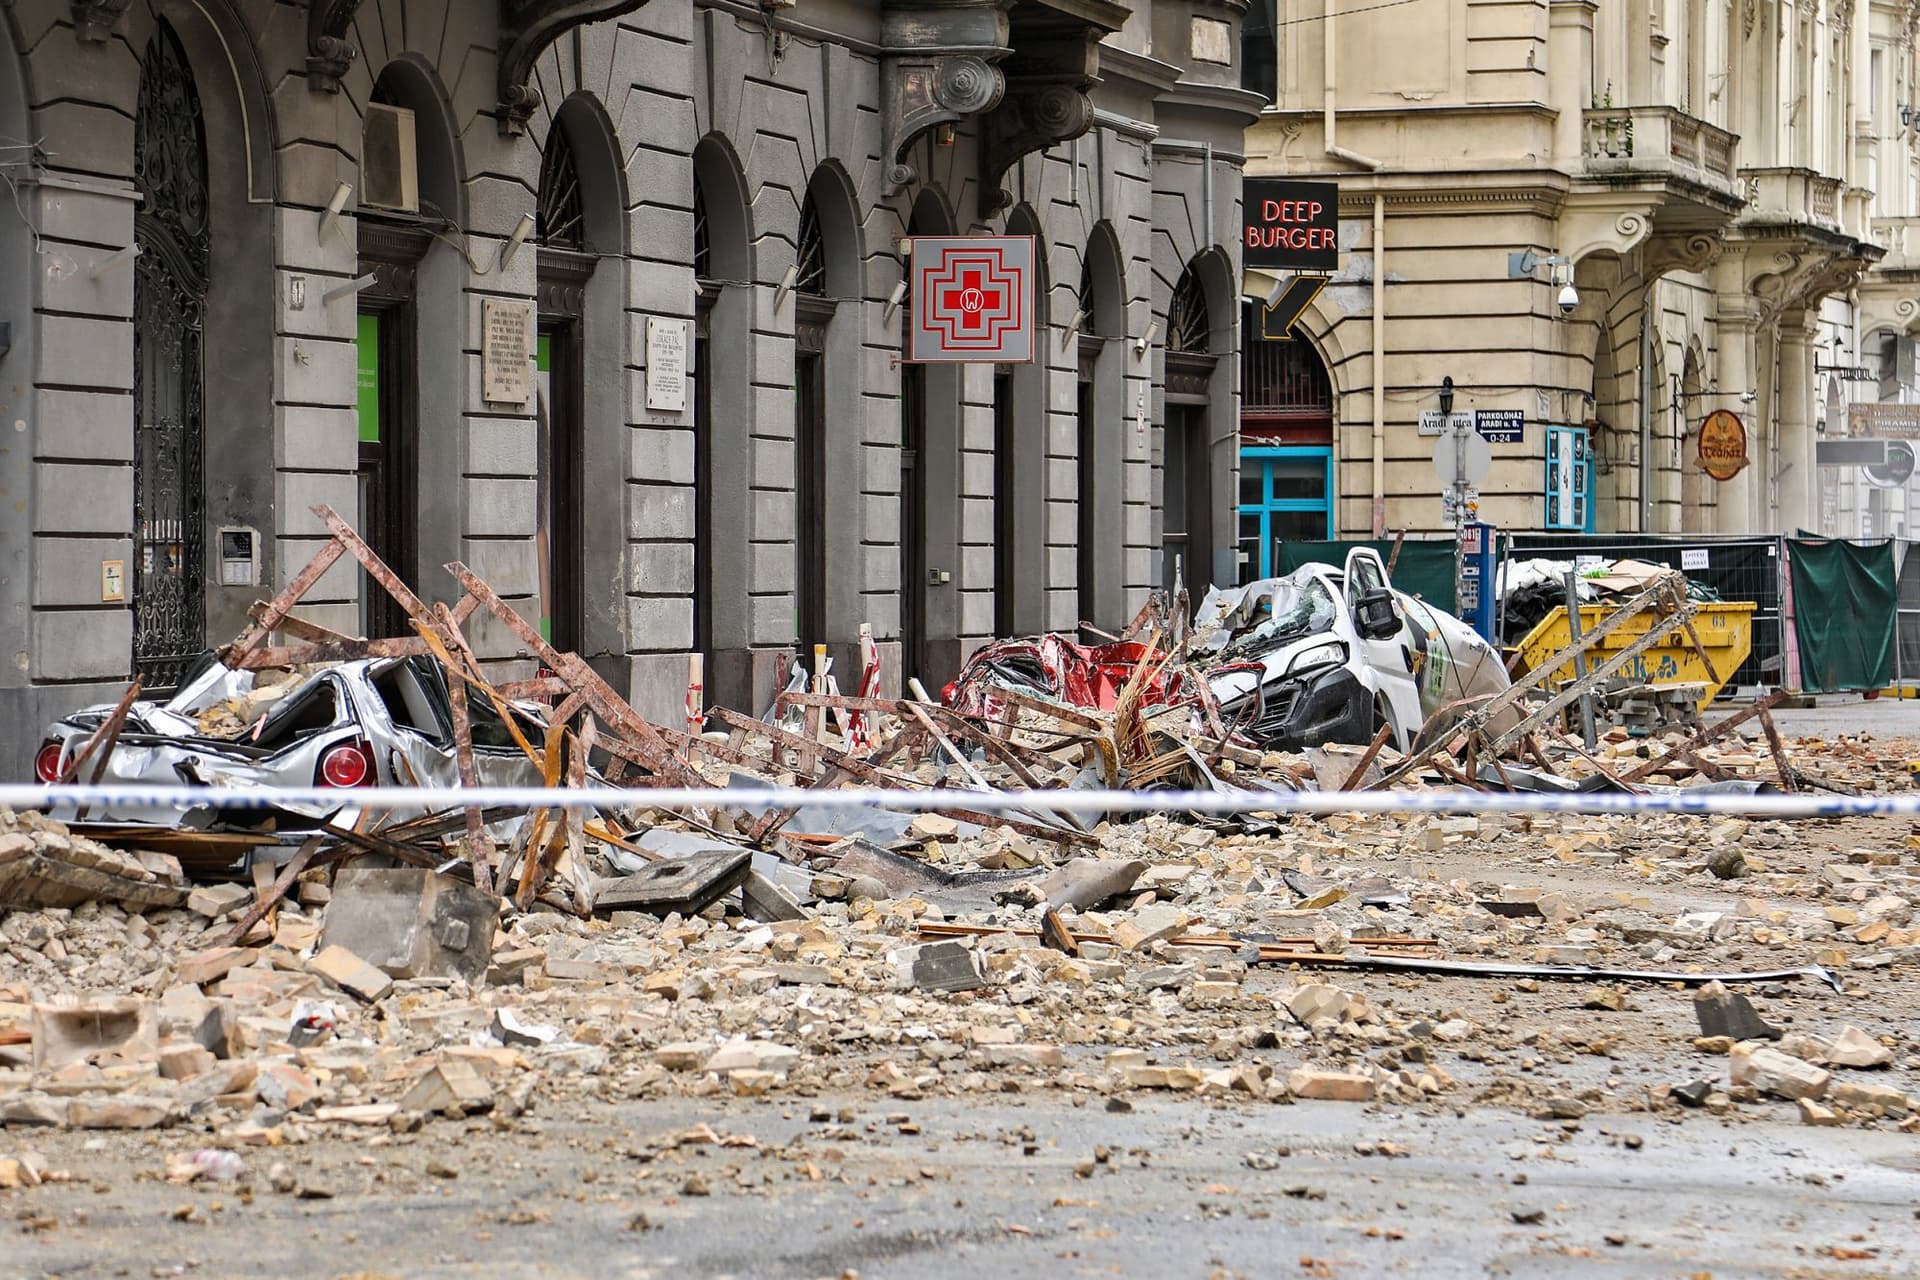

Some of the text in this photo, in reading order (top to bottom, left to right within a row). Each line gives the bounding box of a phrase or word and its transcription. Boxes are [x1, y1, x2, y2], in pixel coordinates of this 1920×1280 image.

[1262, 200, 1322, 223] DEEP
[1245, 226, 1336, 250] BURGER
[1477, 411, 1522, 420] PARKOLÓHÁZ
[1422, 418, 1472, 428] Aradi utca
[1481, 420, 1502, 428] ARADI
[1490, 433, 1511, 442] 0-24
[1712, 615, 1726, 627] 63
